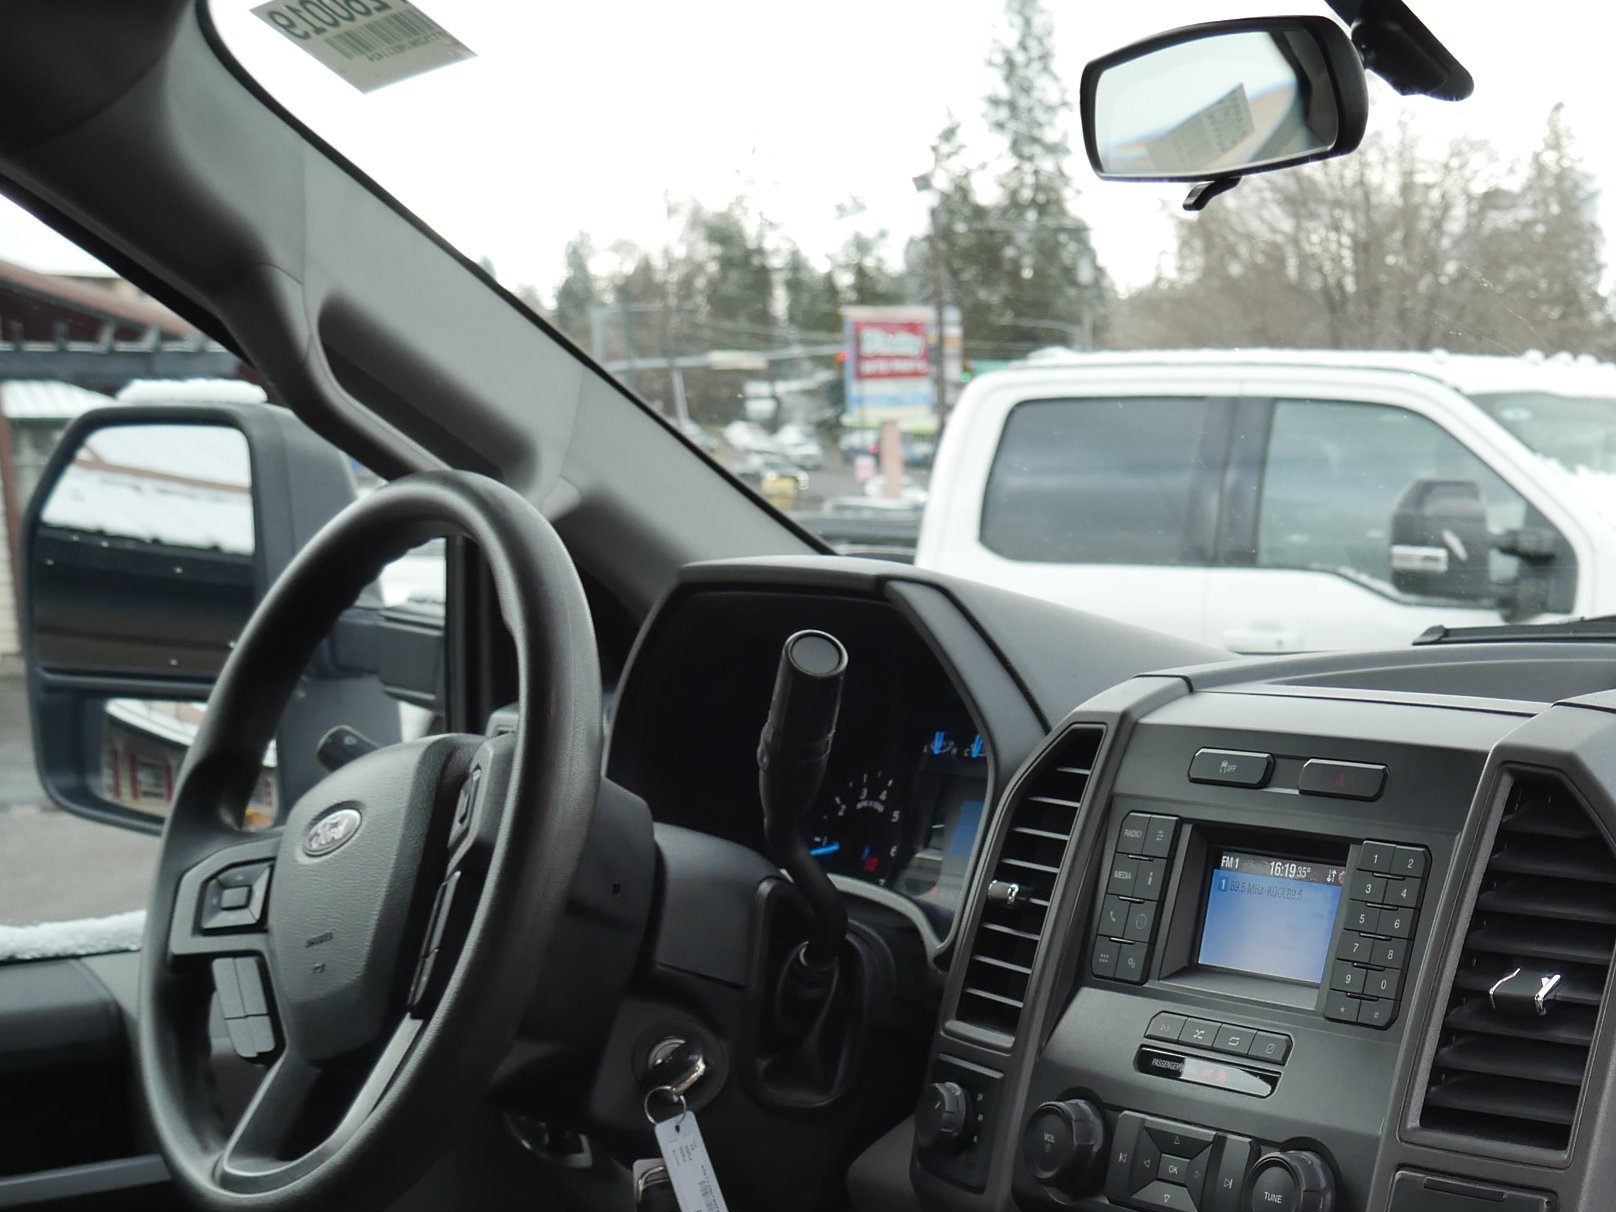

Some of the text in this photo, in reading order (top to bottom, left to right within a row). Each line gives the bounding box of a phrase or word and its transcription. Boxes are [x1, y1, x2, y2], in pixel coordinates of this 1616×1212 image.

[838, 805, 846, 816] 2
[891, 810, 900, 823] 5
[1124, 829, 1142, 839] RADIO
[1373, 854, 1378, 864] 1
[1407, 859, 1414, 869] 2
[1270, 861, 1296, 878] 16:19
[1114, 870, 1132, 880] MEDIA
[1365, 884, 1372, 894] 3
[1401, 889, 1407, 899] 4
[1359, 914, 1365, 924] 5
[1394, 919, 1400, 929] 6
[1353, 943, 1359, 953] 7
[1387, 950, 1394, 960] 8
[1345, 974, 1351, 984] 9
[1380, 980, 1387, 990] 0
[1168, 1164, 1179, 1175] OK
[1264, 1191, 1282, 1205] TUNE
